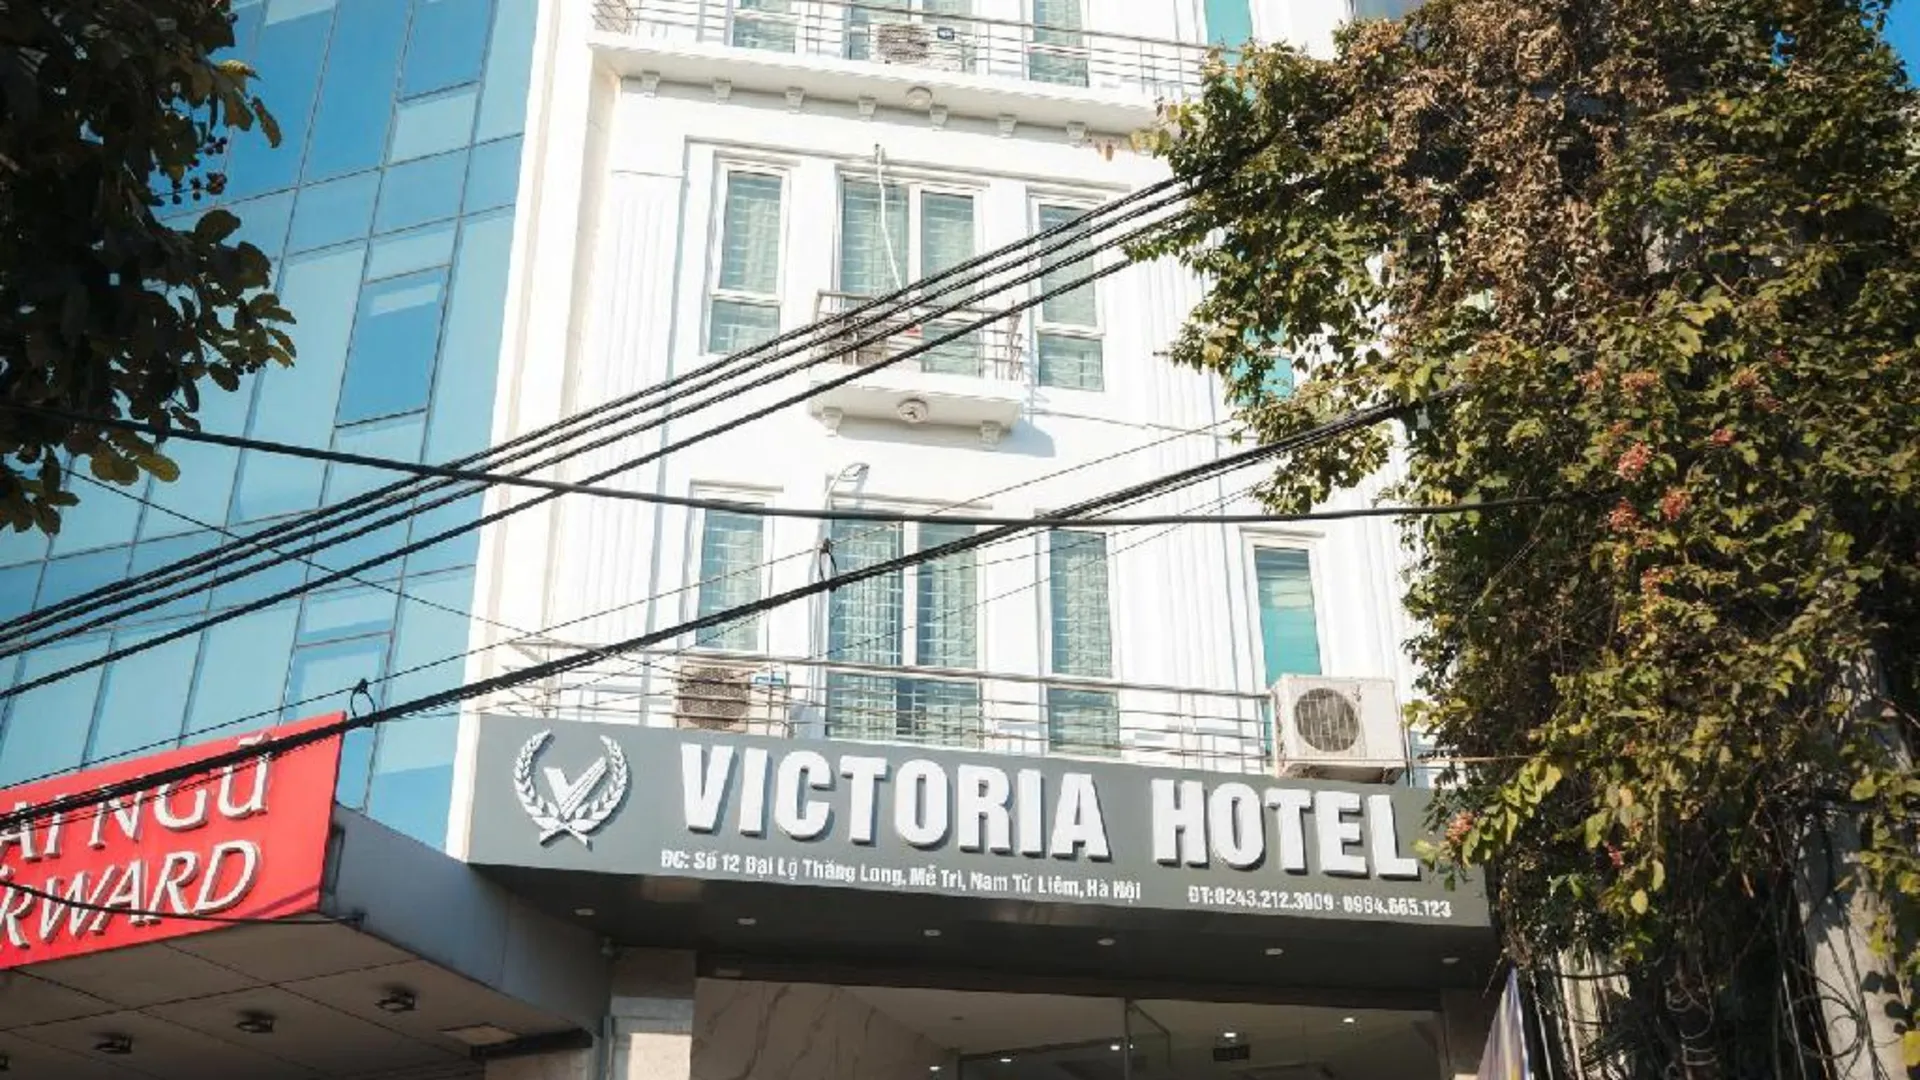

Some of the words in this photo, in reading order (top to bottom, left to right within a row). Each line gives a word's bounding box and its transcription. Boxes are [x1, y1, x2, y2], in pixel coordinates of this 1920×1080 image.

[681, 742, 1111, 861] VICTORIA
[1151, 778, 1420, 880] HOTEL
[693, 849, 718, 871] Số
[721, 853, 741, 873] 12
[745, 855, 773, 879] Đại
[802, 857, 856, 882] Thăng
[860, 863, 906, 886] Long,
[970, 871, 1008, 892] Nam
[1012, 872, 1034, 894] Từ
[1038, 874, 1084, 898] Liêm,
[1087, 878, 1109, 898] Hà
[1113, 880, 1141, 904] Nội
